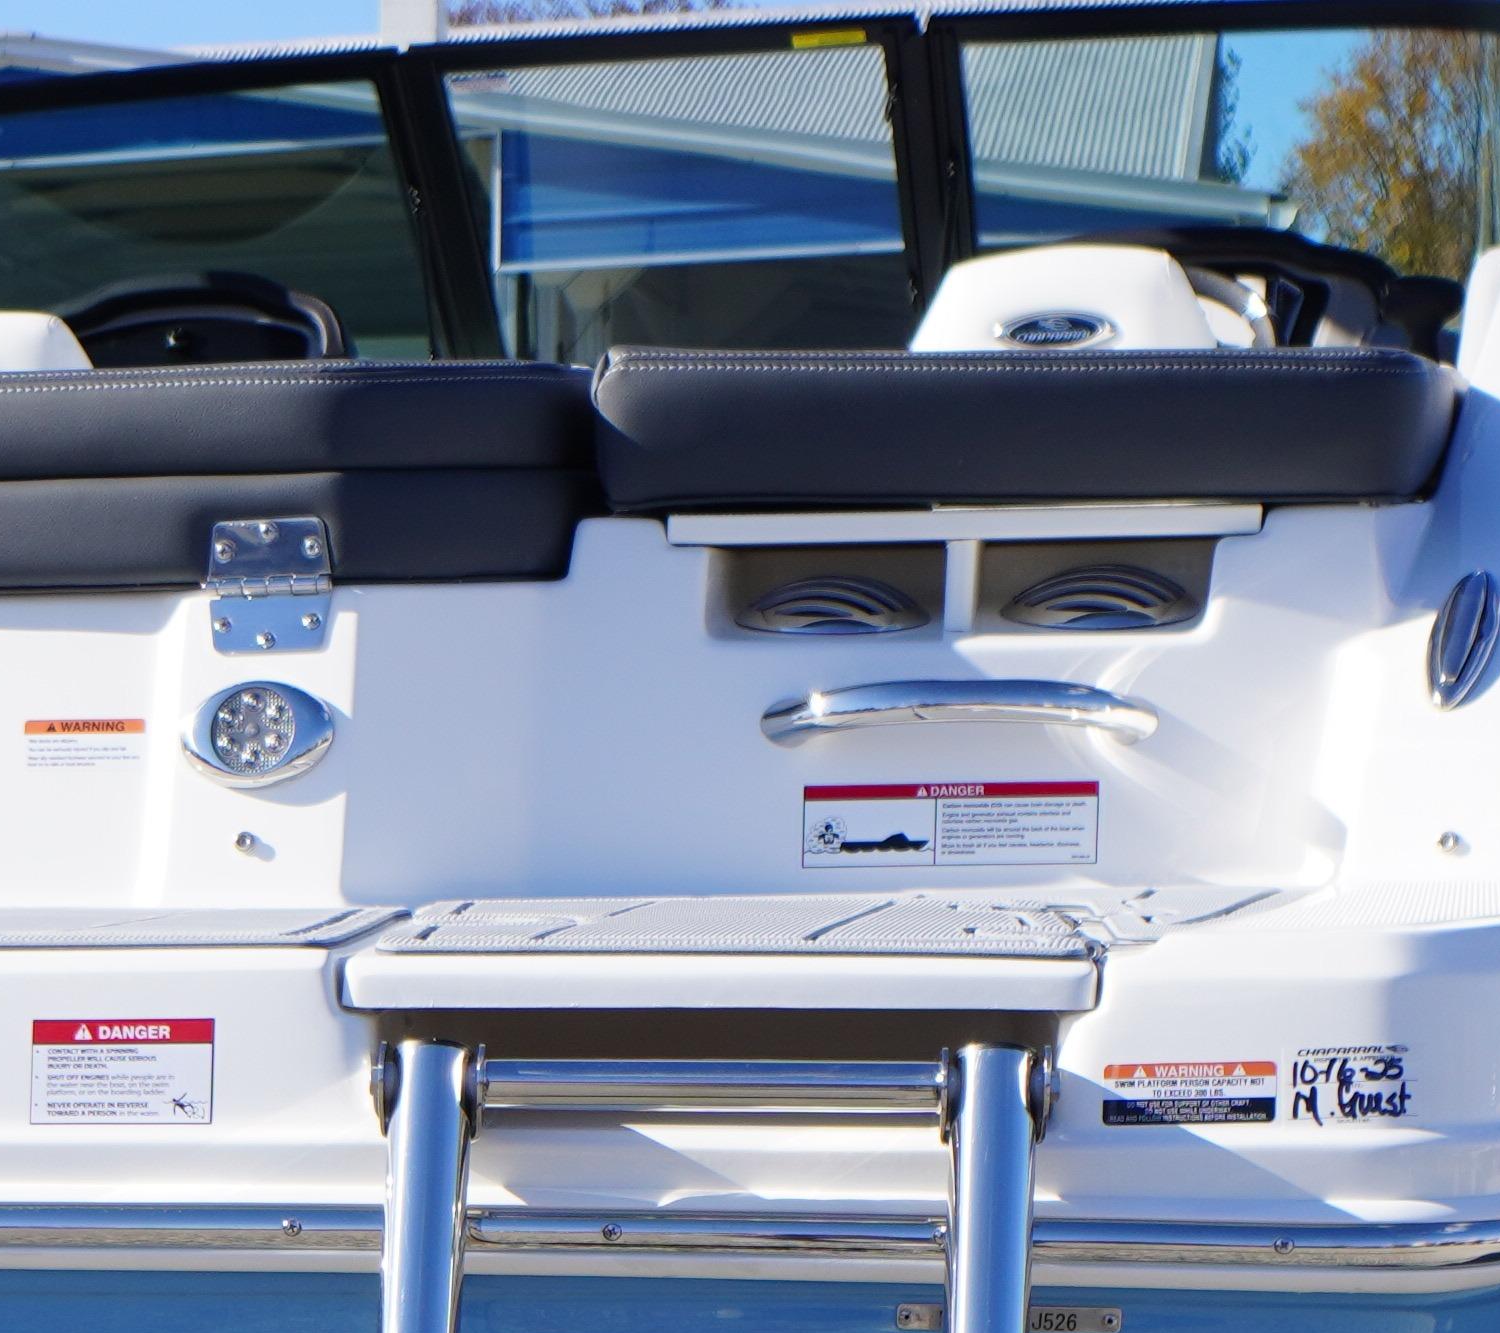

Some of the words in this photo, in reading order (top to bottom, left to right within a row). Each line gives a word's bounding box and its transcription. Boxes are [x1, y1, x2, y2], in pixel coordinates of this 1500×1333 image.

[61, 721, 125, 732] WARNING
[931, 785, 984, 797] DANGER
[98, 1025, 171, 1040] DANGER
[1155, 1065, 1224, 1077] WARNING
